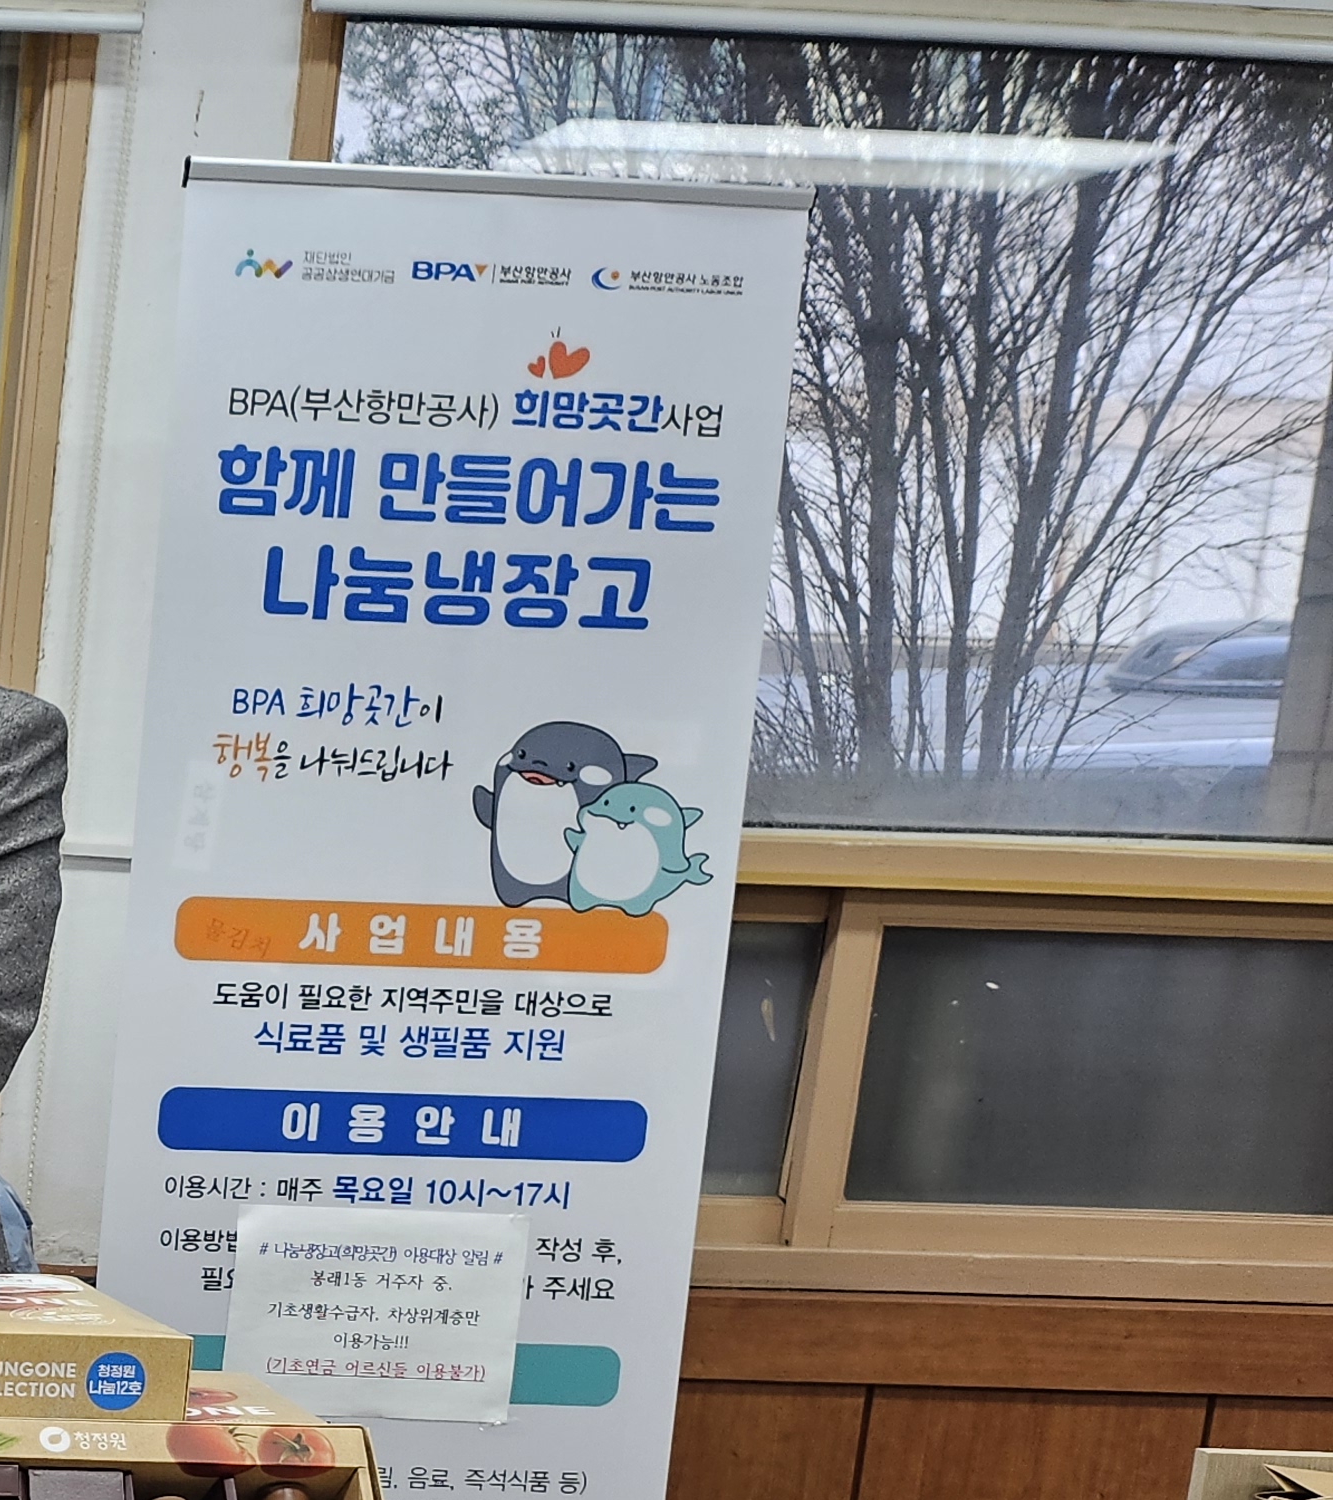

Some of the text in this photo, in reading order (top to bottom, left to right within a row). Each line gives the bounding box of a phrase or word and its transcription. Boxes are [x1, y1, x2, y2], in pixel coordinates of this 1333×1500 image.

[303, 250, 352, 265] 재단법인
[411, 261, 476, 281] BPA
[499, 265, 572, 281] 부산항만공사
[630, 270, 745, 289] 부산항만공사 노동조합
[229, 385, 724, 438] BPA(부산항만공사) 희망곳간사업
[217, 445, 720, 532] 함께 만들어가는
[262, 545, 651, 631] 나눔냉장고
[232, 682, 443, 728] BPA 희망곳간이
[213, 731, 454, 783] 행복을 나눠드립니다
[213, 981, 613, 1019] 도움이 필요한 지역주민을 대상으로
[254, 1021, 565, 1062] 식료품 및 생필품 지원
[163, 1174, 572, 1210] 이용시간 매주 목요일 10시~17시
[462, 1250, 488, 1266] 알림
[535, 1236, 622, 1266] 작성 후,
[310, 1270, 367, 1289] 봉래1동
[375, 1274, 423, 1291] 거주자
[542, 1276, 615, 1303] 주세요
[388, 1307, 480, 1327] 차상위계층만
[333, 1333, 409, 1352] 이용가능!!!
[267, 1357, 486, 1382] (기초연금 어르신들 이용불가)
[88, 1379, 143, 1397] 나눔12호
[407, 1467, 588, 1494] 음료, 즉석식품 등)
